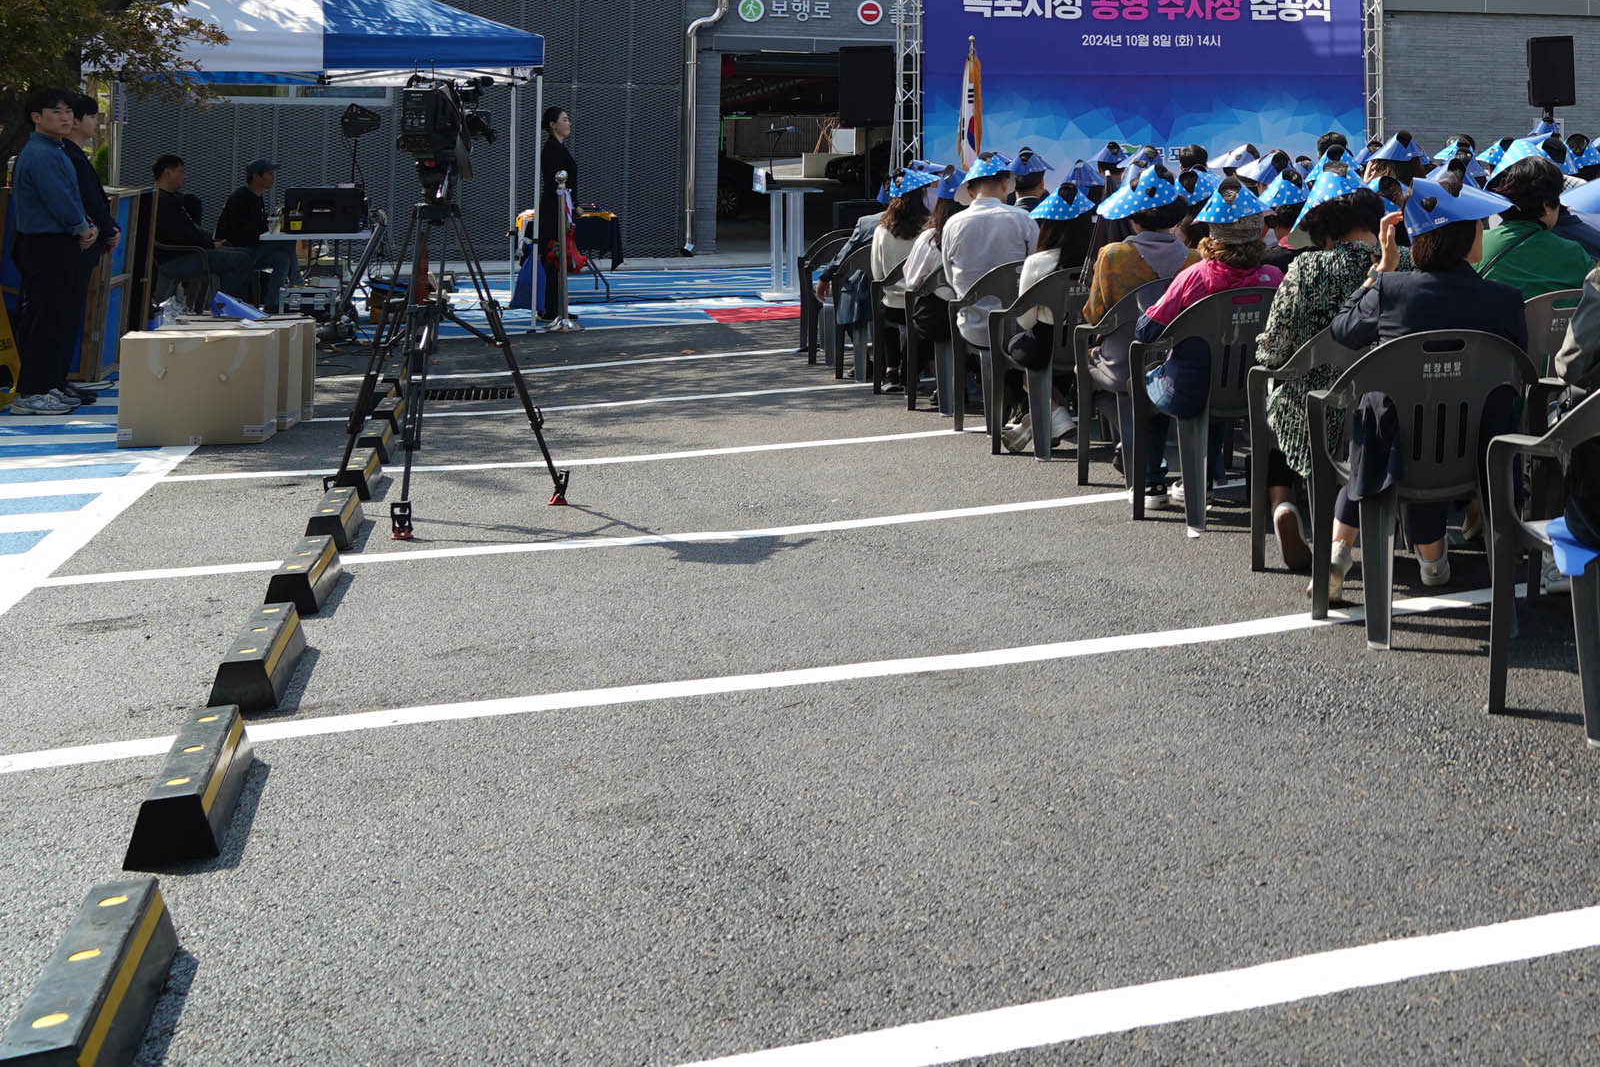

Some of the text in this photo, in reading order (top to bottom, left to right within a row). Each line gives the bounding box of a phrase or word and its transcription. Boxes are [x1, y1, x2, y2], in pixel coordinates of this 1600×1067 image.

[769, 0, 832, 22] 보행로
[1081, 34, 1221, 47] 2024년 10월 8일 (화) 14시
